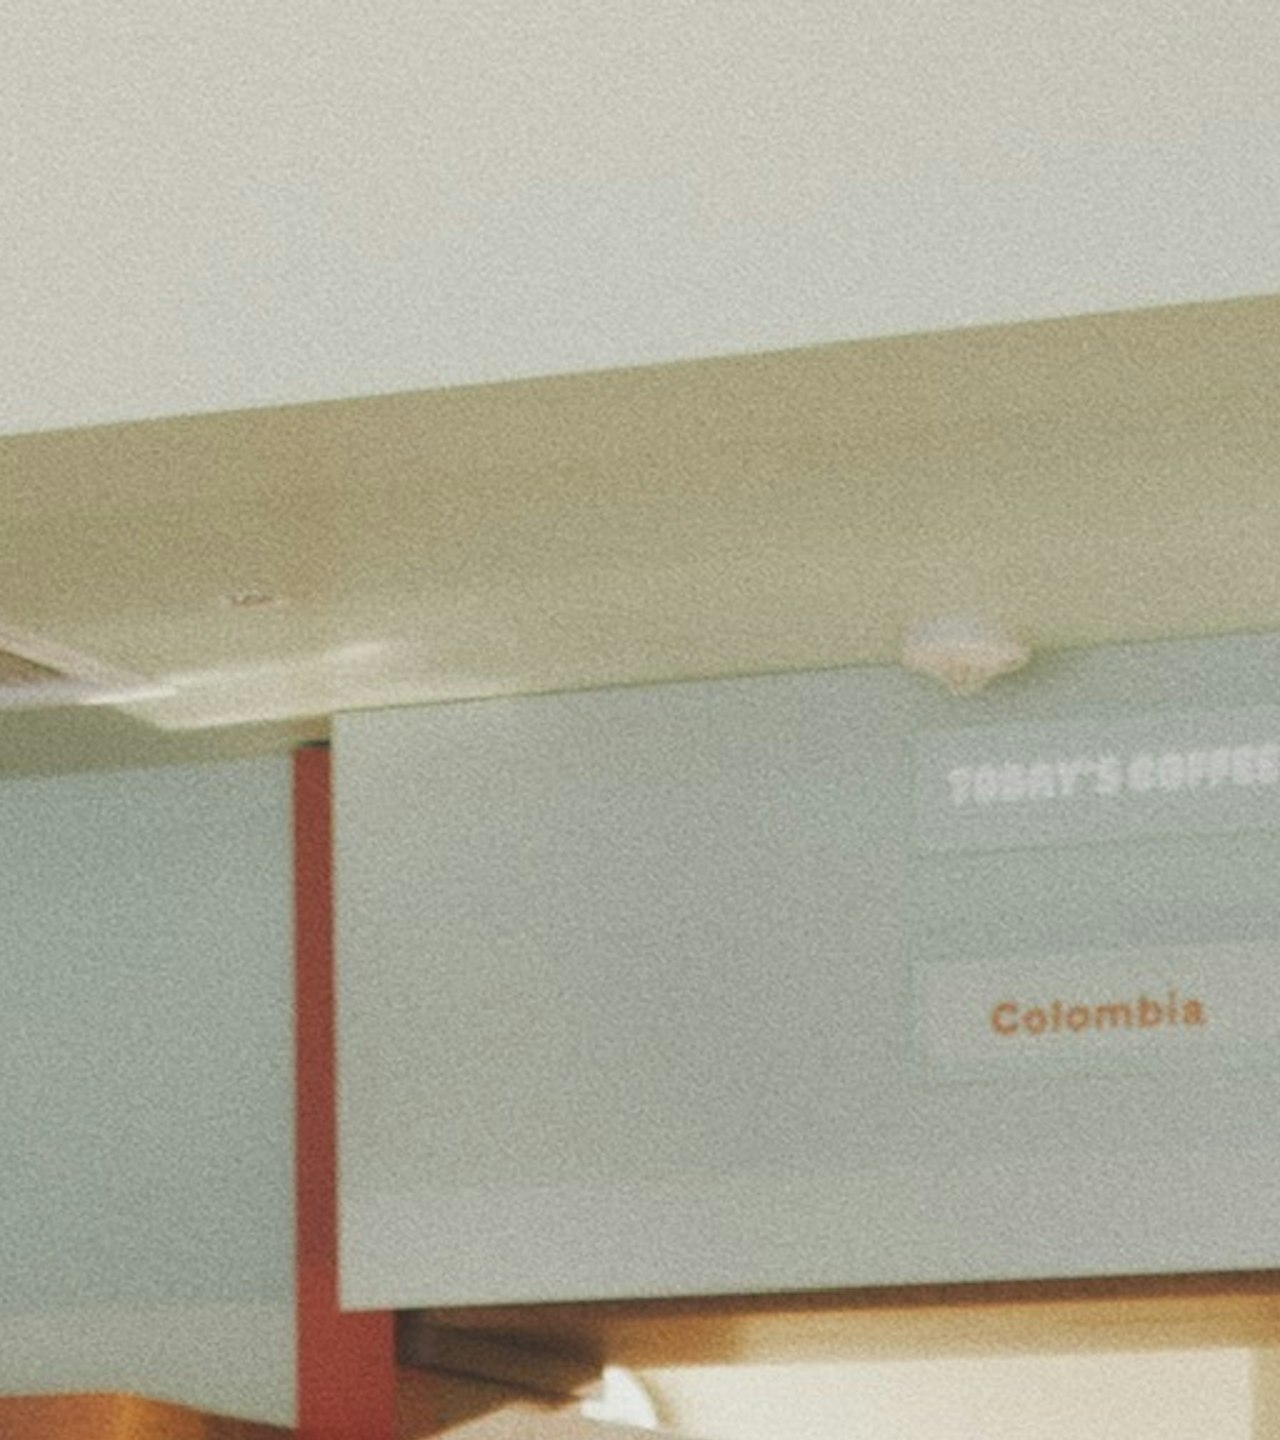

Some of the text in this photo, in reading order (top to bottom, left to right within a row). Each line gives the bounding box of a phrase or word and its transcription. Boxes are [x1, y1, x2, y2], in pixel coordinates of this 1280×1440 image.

[947, 744, 1280, 801] TODAY'S COFFEE
[991, 990, 1208, 1036] Colombia
